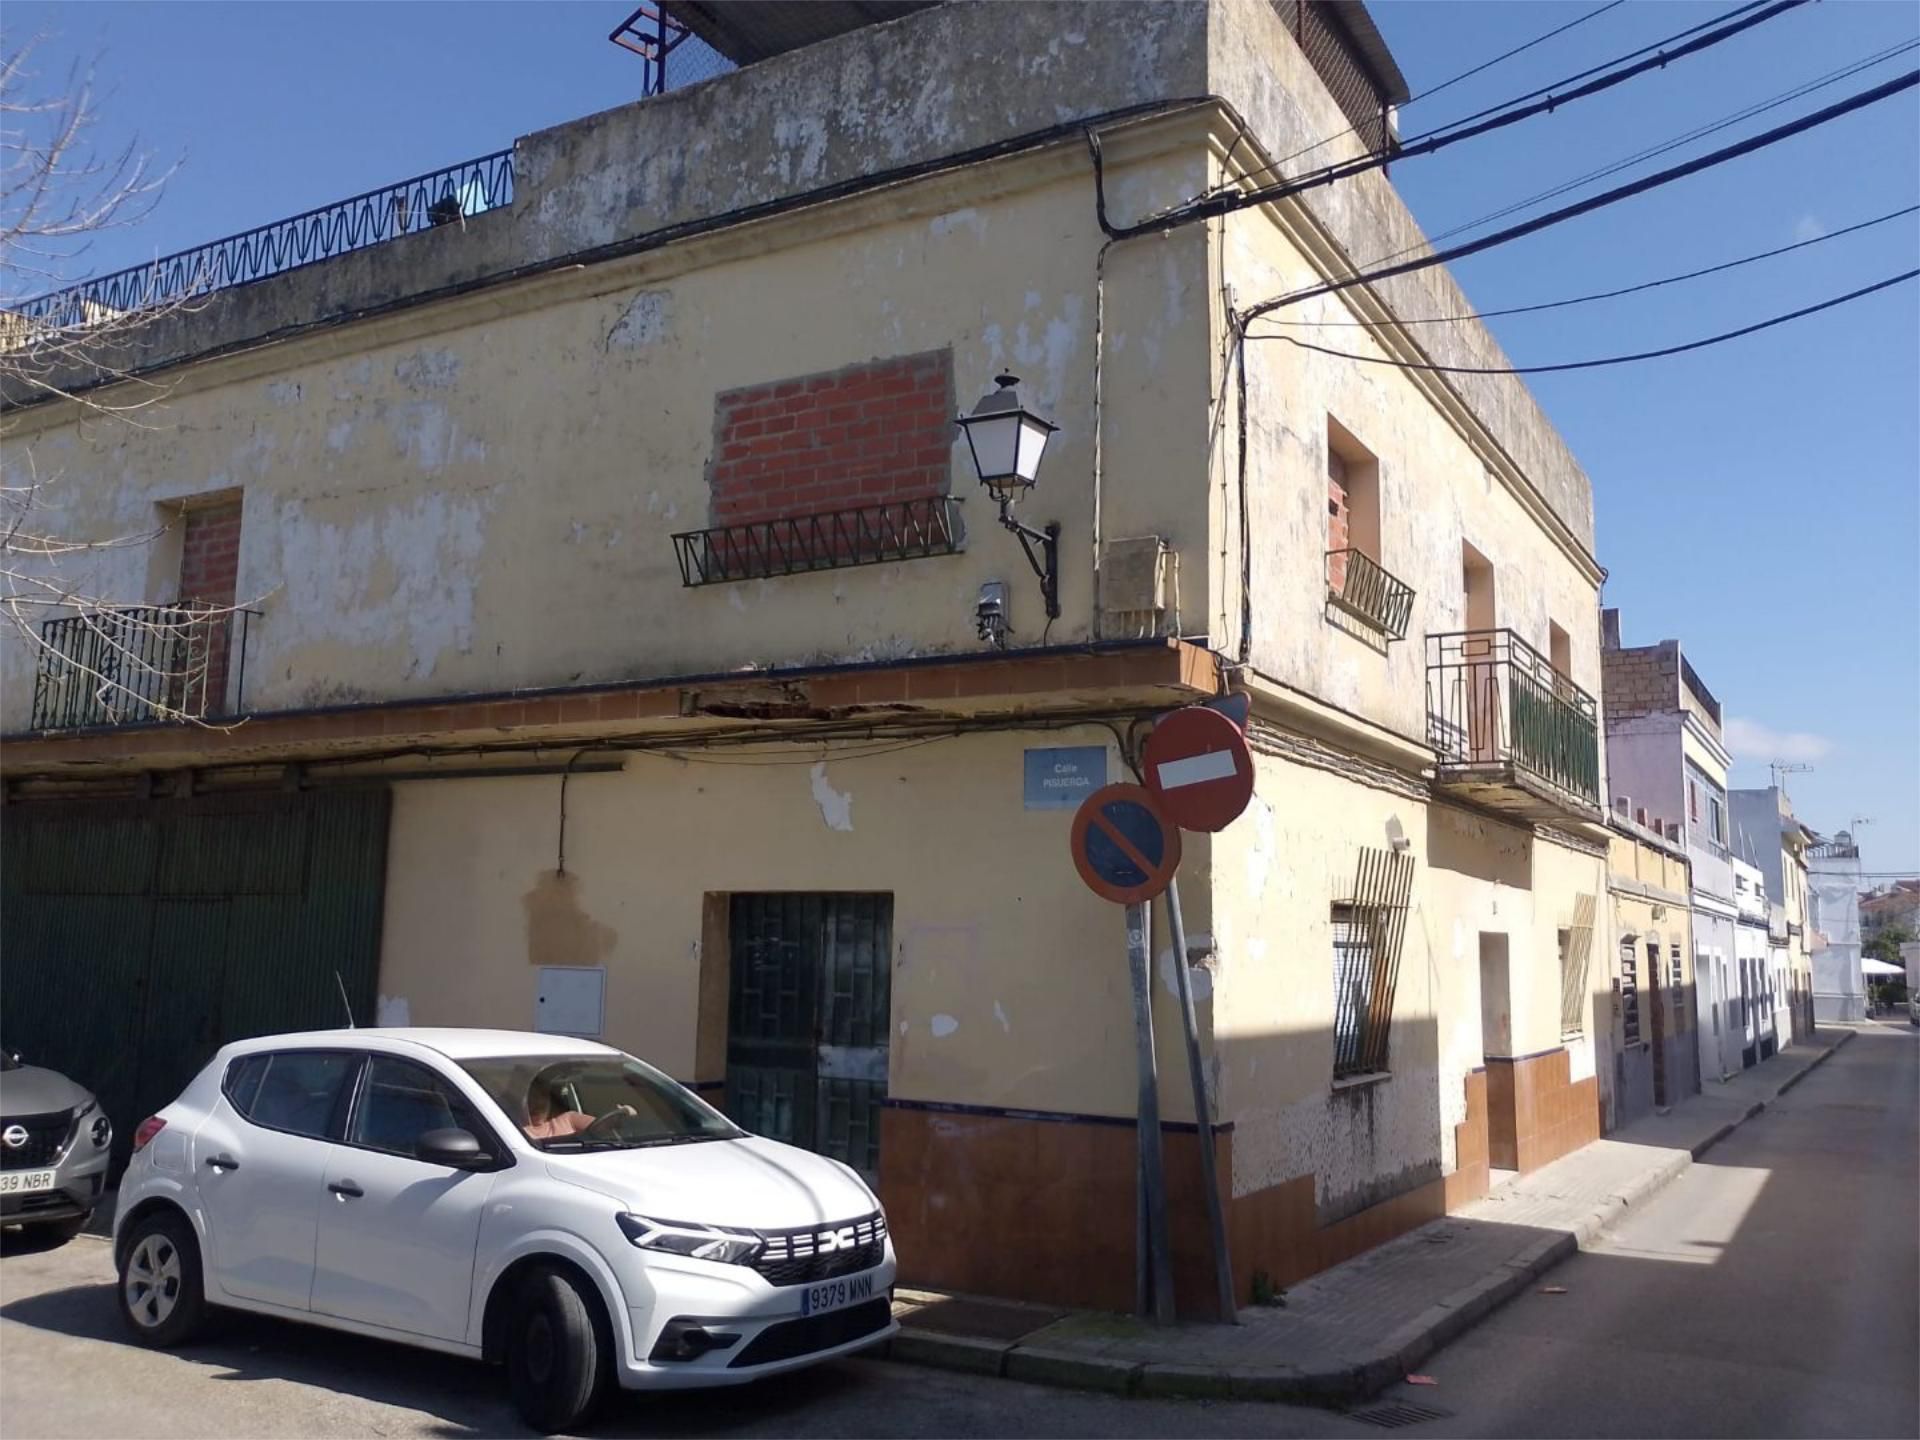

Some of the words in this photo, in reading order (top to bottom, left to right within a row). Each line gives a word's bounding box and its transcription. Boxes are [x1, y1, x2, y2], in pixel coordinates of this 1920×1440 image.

[23, 1172, 51, 1188] NBR
[811, 1283, 845, 1310] 9379
[849, 1275, 872, 1301] MNN
